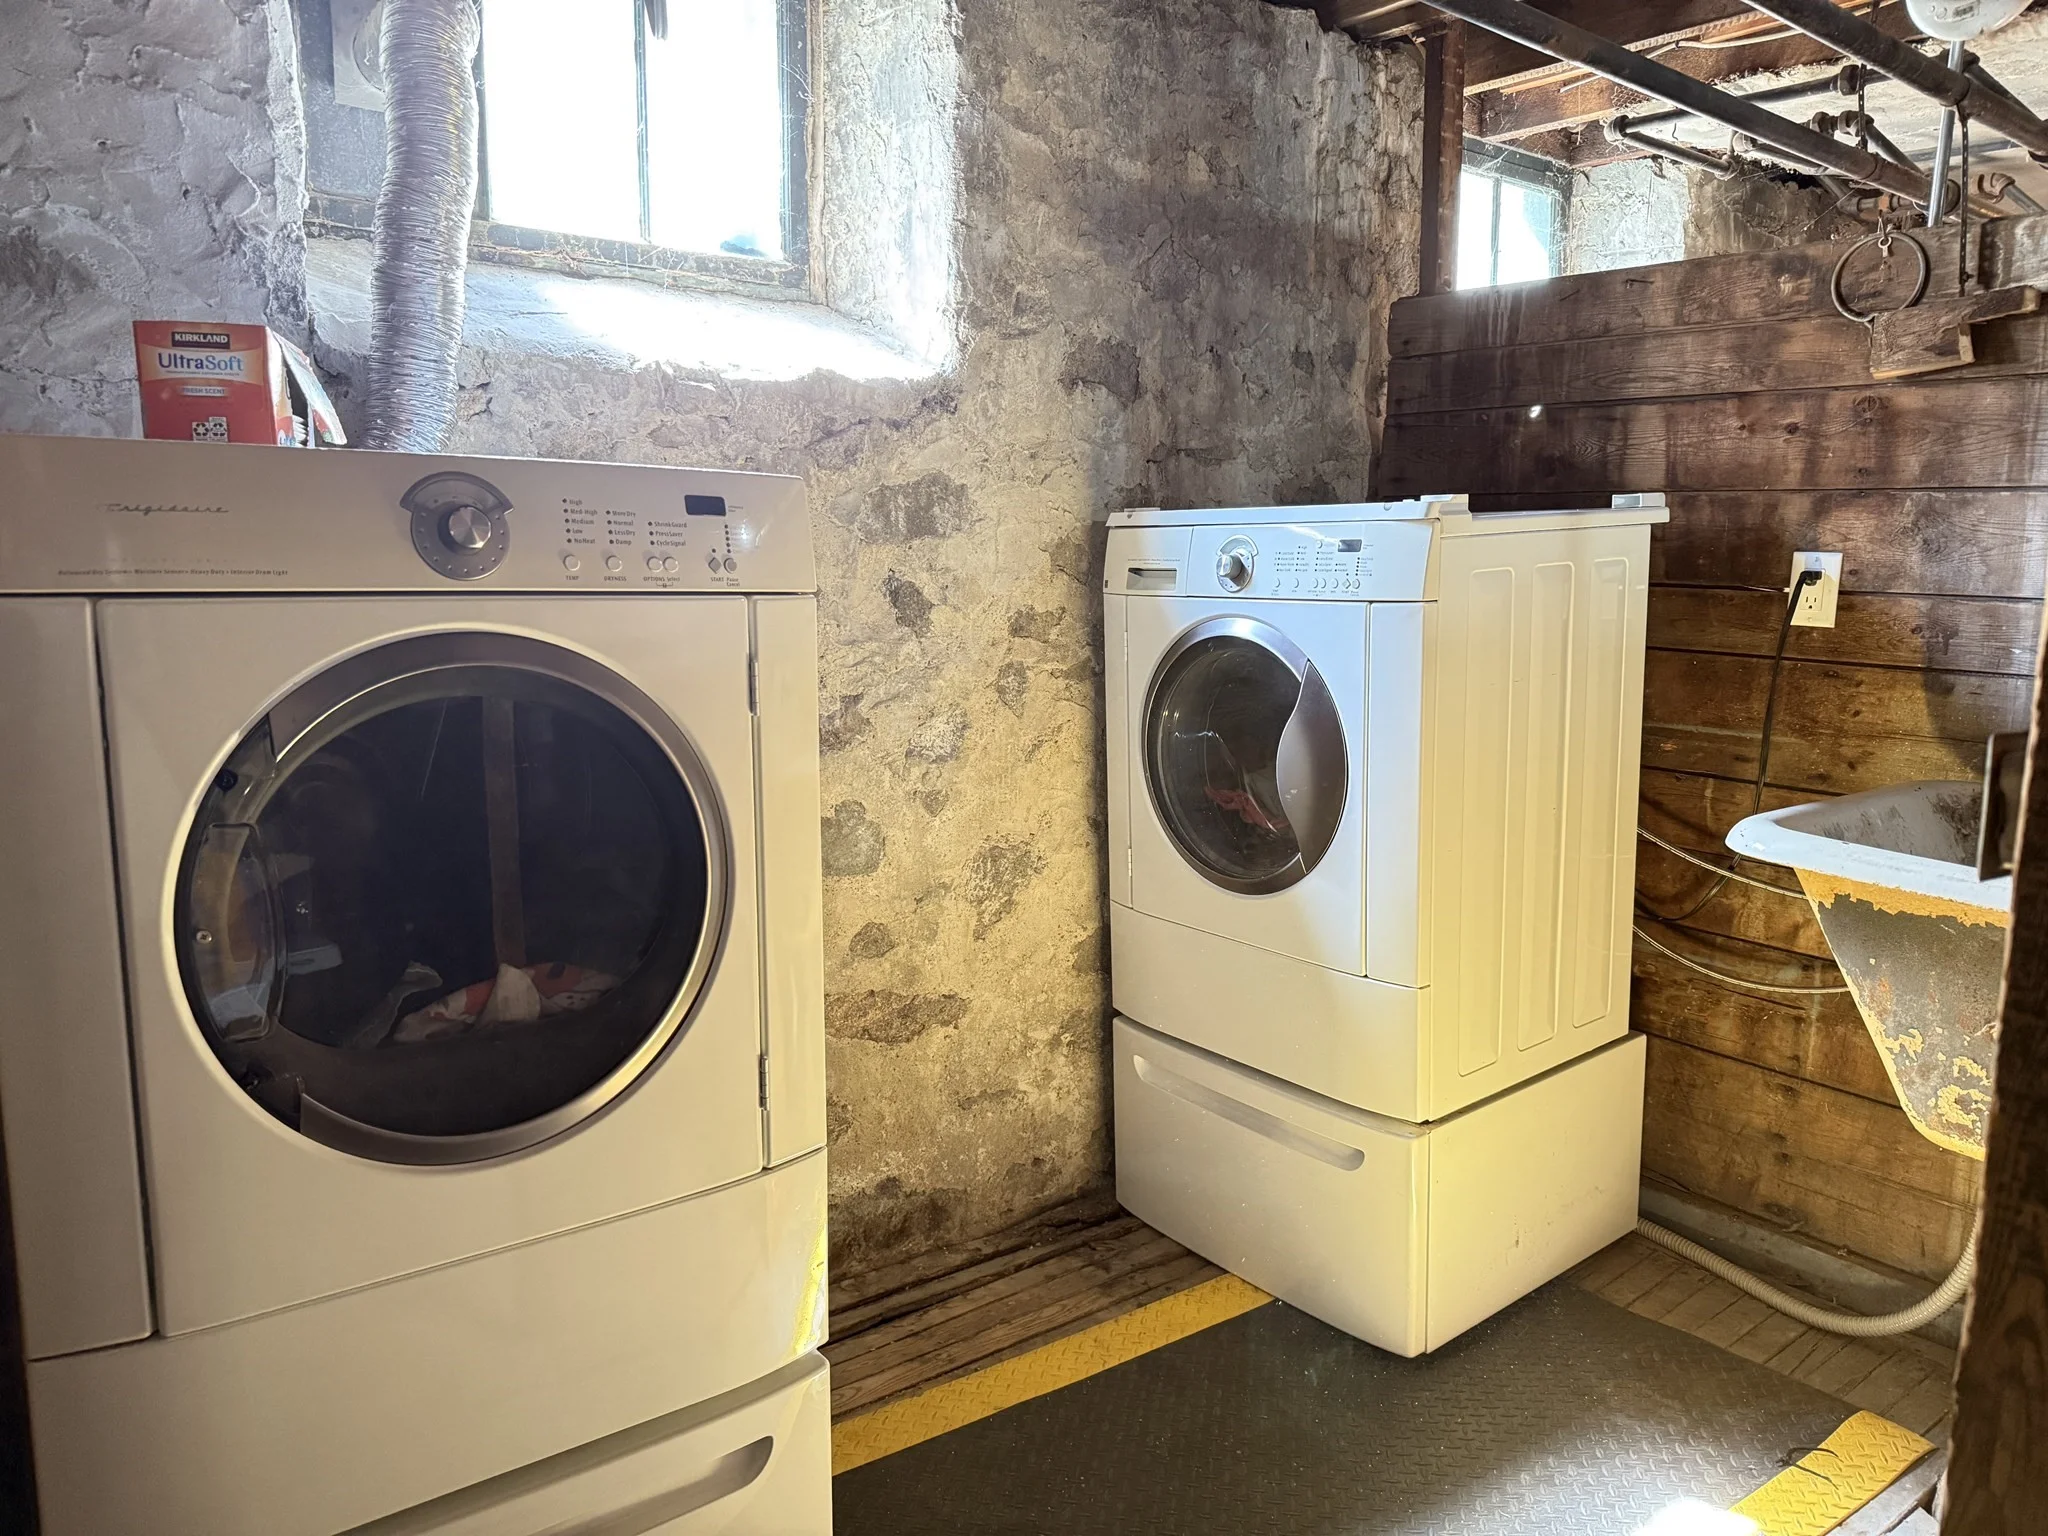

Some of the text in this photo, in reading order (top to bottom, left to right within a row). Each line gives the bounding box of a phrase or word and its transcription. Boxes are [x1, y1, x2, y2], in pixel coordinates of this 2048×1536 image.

[174, 333, 228, 343] KIRKLAND
[158, 352, 243, 371] UltraSoft
[616, 538, 632, 546] Damp
